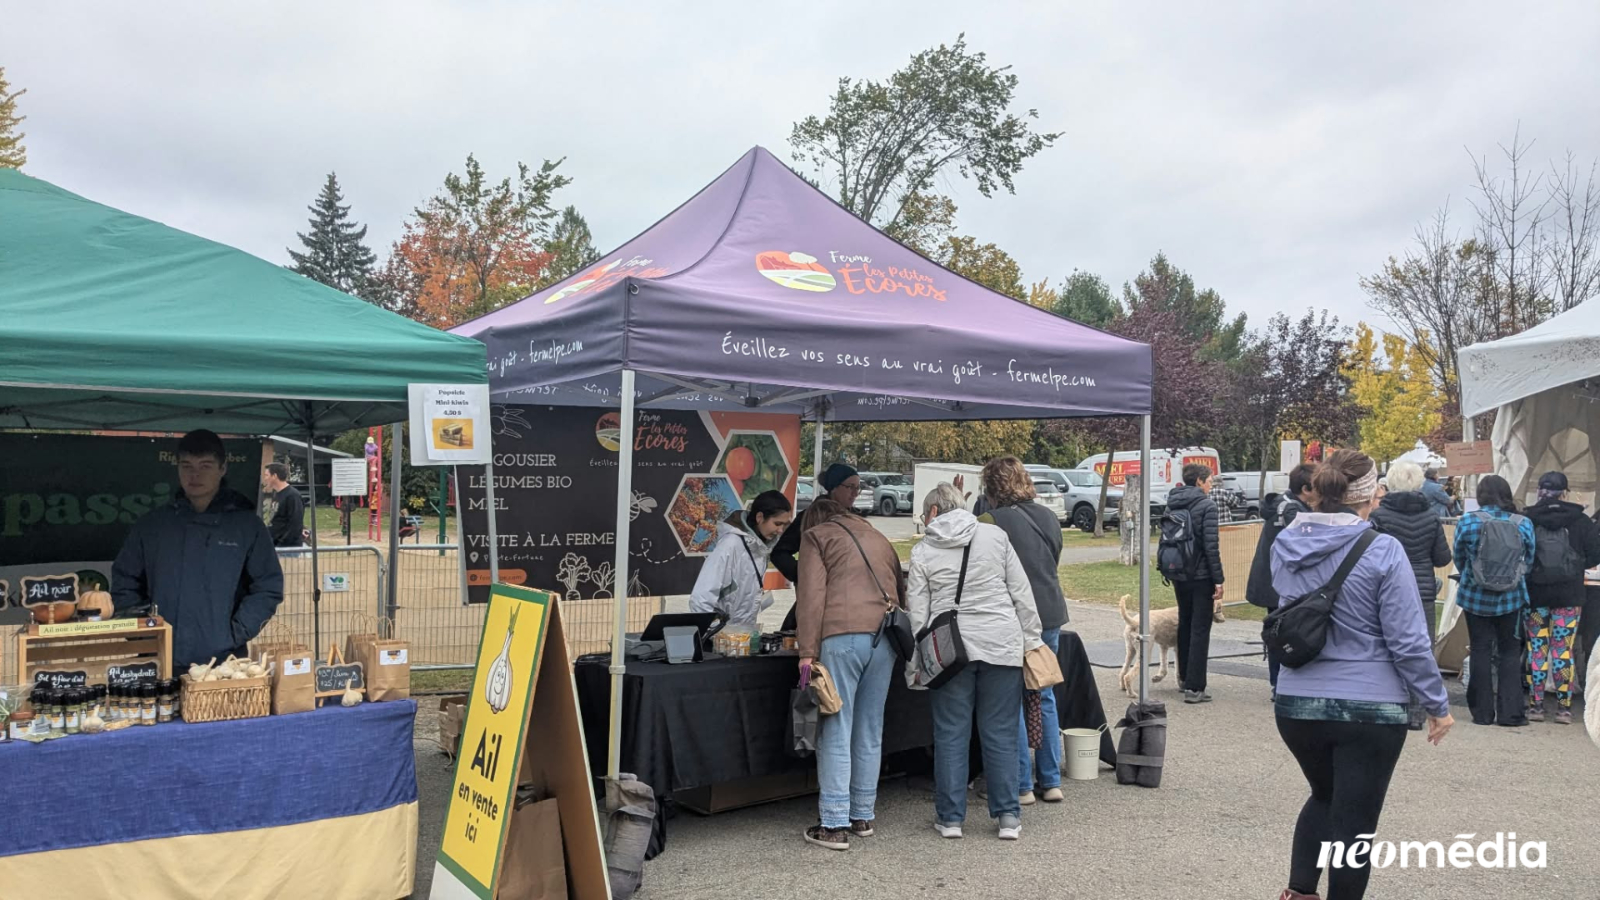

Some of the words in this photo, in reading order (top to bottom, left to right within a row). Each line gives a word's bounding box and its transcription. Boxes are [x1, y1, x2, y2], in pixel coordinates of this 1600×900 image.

[829, 250, 872, 263] Ferme
[837, 263, 947, 301] Écores
[486, 356, 497, 371] rai
[529, 339, 584, 365] fermelpe.com
[721, 331, 790, 359] Éveillez
[801, 349, 825, 363] vos
[836, 352, 870, 367] sens
[881, 358, 903, 370] au
[913, 359, 943, 374] vrai
[952, 361, 983, 385] goût
[1006, 358, 1096, 391] fermelpe.com
[638, 410, 661, 422] Ferme
[493, 454, 557, 467] GOUSIER
[1095, 463, 1126, 475] MEL
[546, 476, 573, 489] BIO
[468, 497, 509, 510] MEL
[467, 534, 519, 547] VISTE
[522, 532, 536, 547] À
[540, 534, 561, 547] LA
[566, 532, 614, 545] FERME
[29, 583, 49, 599] Ail
[51, 584, 72, 599] noir
[470, 726, 502, 782] Ail
[458, 781, 470, 802] en
[472, 789, 498, 821] vente
[465, 812, 479, 843] ici
